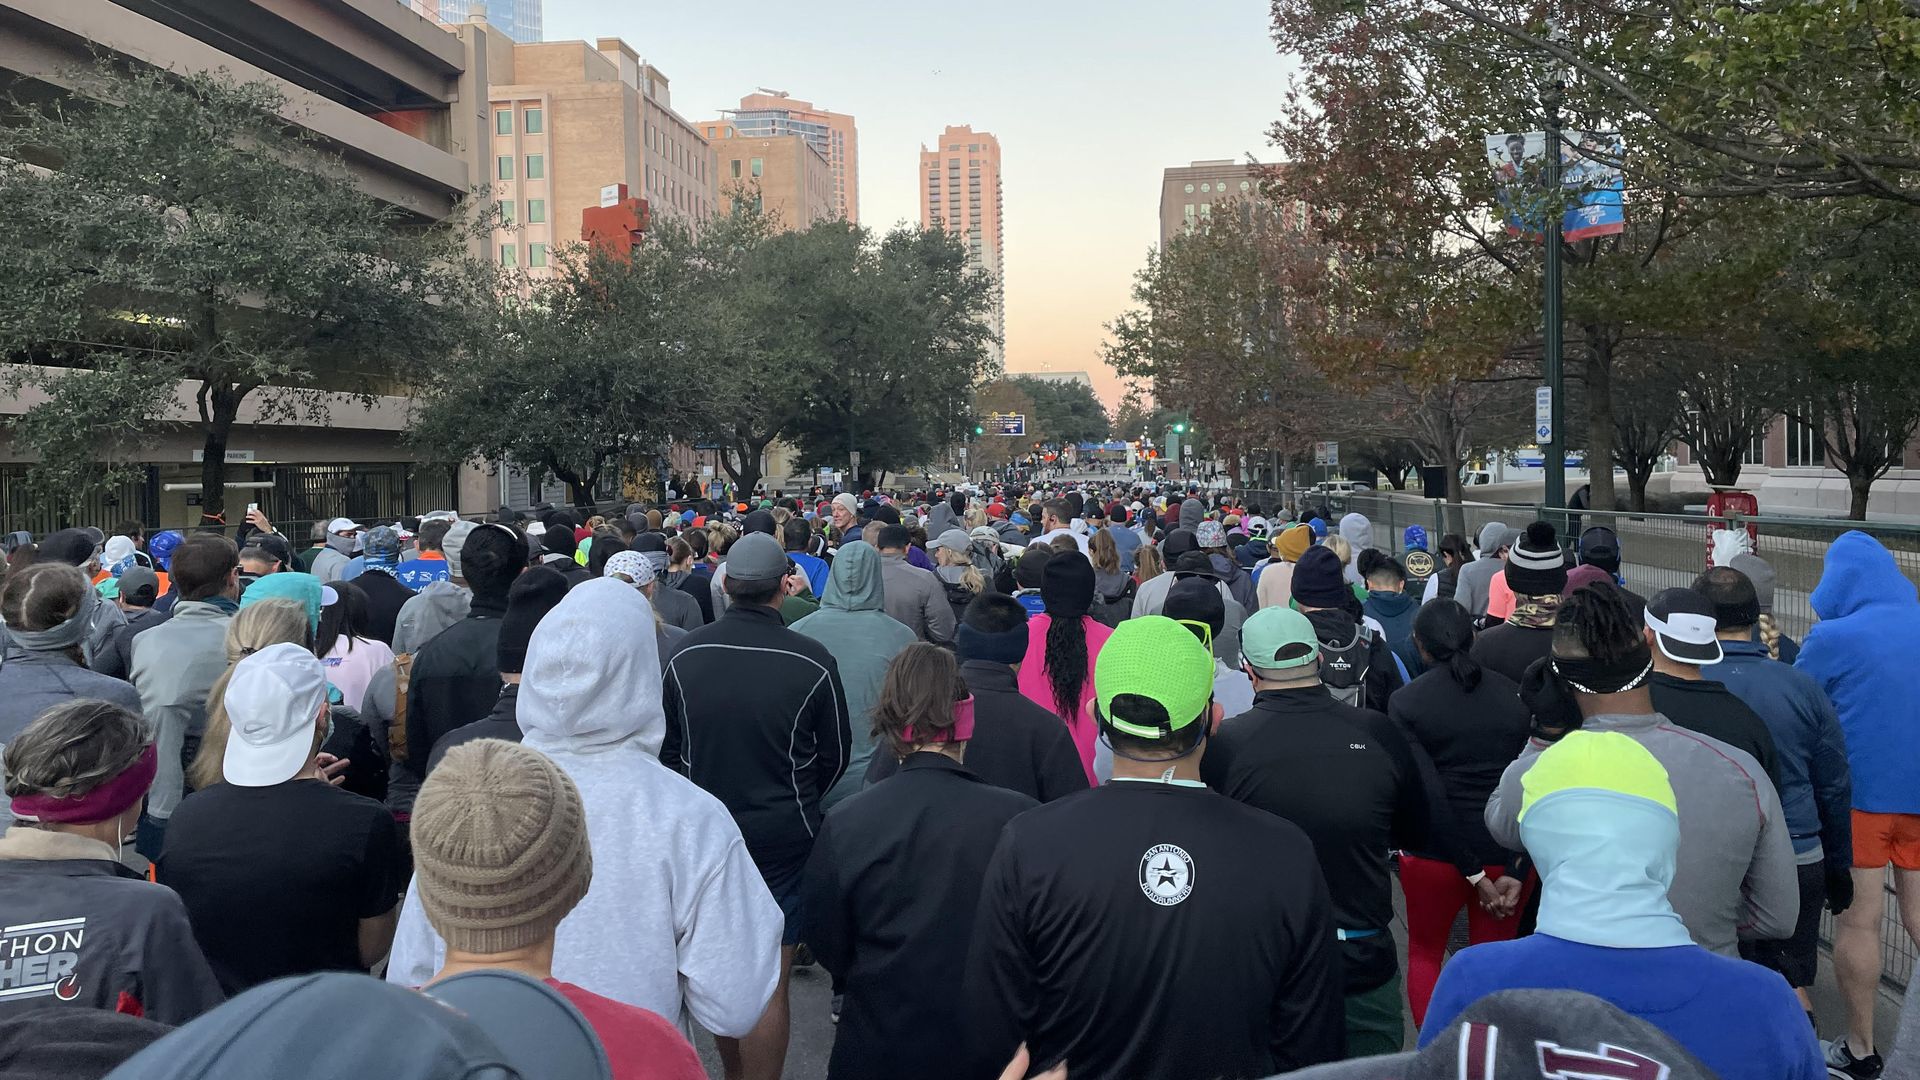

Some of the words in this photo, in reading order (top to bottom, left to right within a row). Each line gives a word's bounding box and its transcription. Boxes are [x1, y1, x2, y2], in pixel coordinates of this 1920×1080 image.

[1145, 848, 1159, 861] SAN
[1159, 845, 1190, 863] ANTONIO
[1142, 882, 1191, 905] ROADRUNNERS
